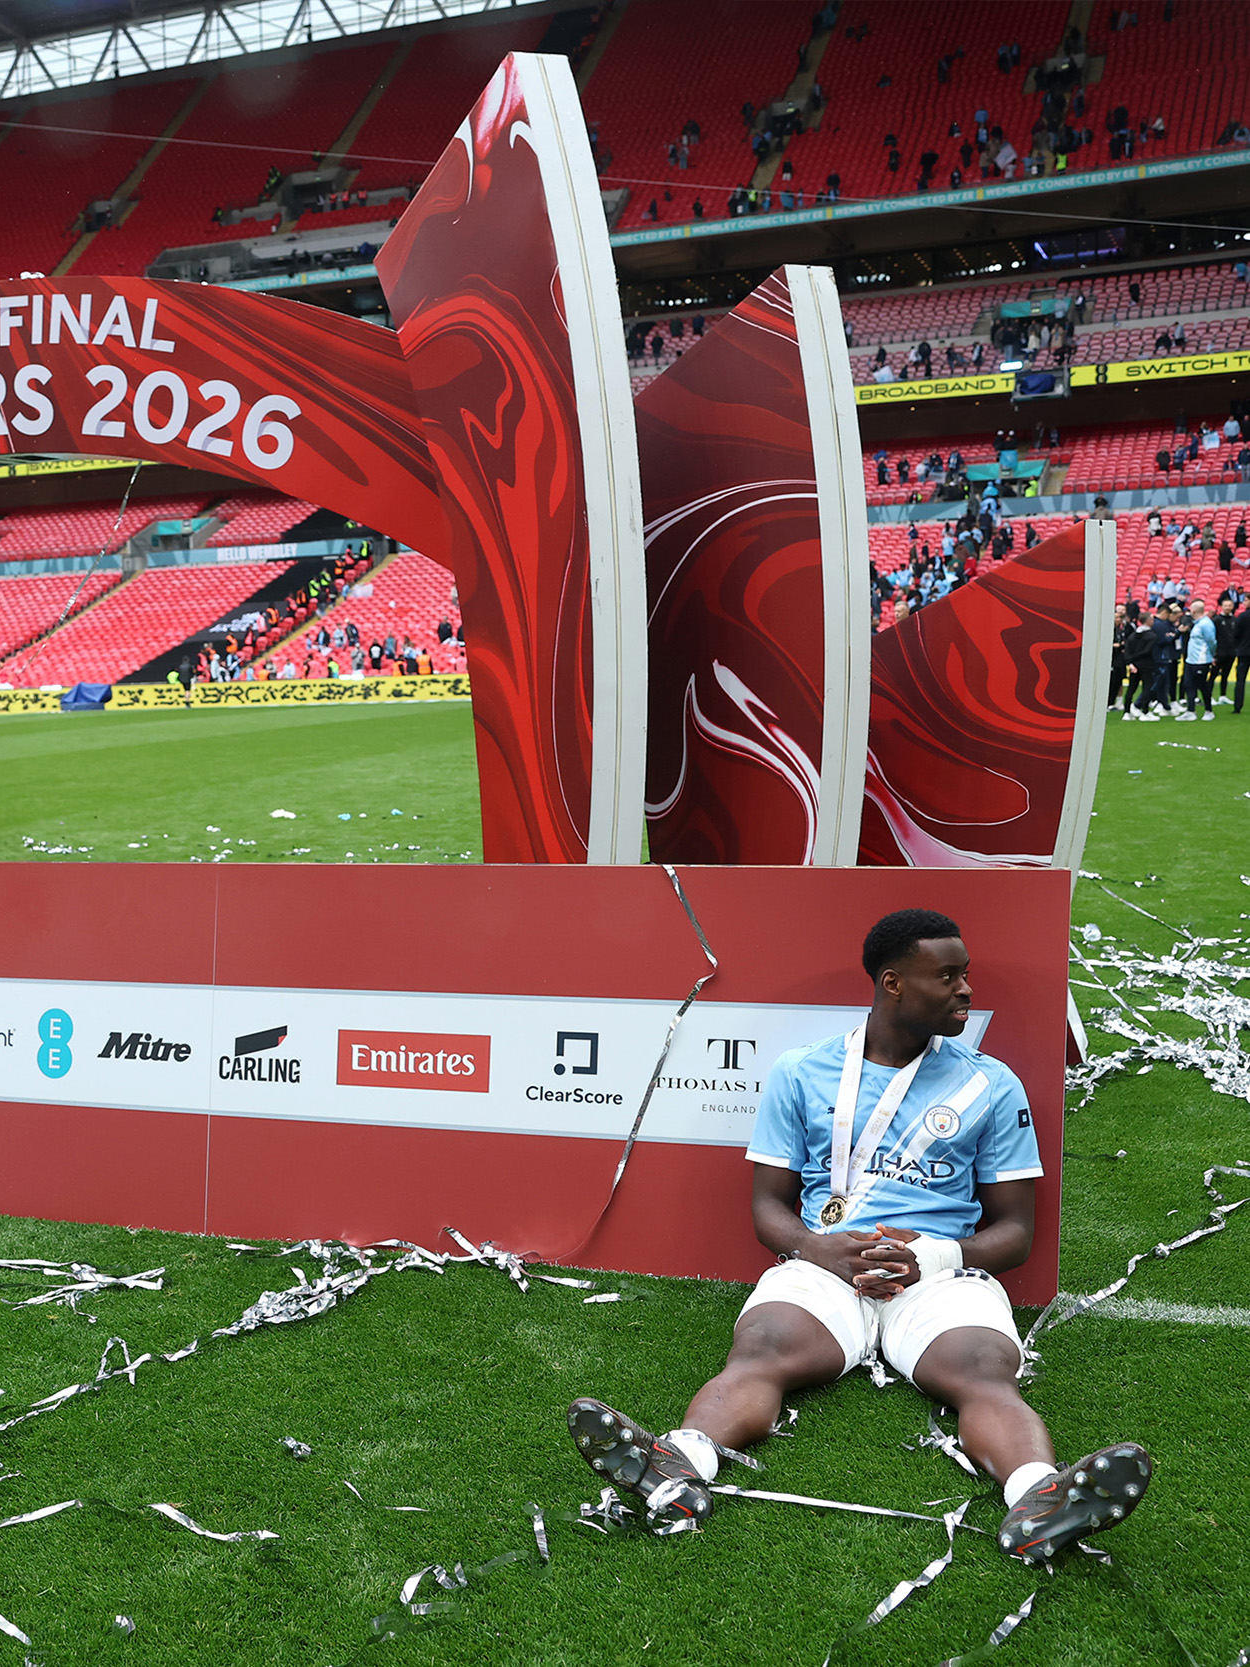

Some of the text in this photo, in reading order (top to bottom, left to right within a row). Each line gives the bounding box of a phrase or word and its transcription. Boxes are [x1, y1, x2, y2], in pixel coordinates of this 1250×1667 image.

[0, 294, 176, 354] FINAL
[1126, 355, 1250, 377] SWITCH T
[859, 379, 996, 401] BROADBAND
[81, 364, 303, 471] 2026
[97, 1031, 191, 1063] Mitre
[351, 1043, 476, 1077] Emirates
[218, 1055, 300, 1084] CARLING
[525, 1084, 623, 1106] ClearScore
[656, 1076, 747, 1093] THOMAS
[701, 1103, 757, 1115] ENGLAND
[821, 1152, 956, 1179] EIHAD
